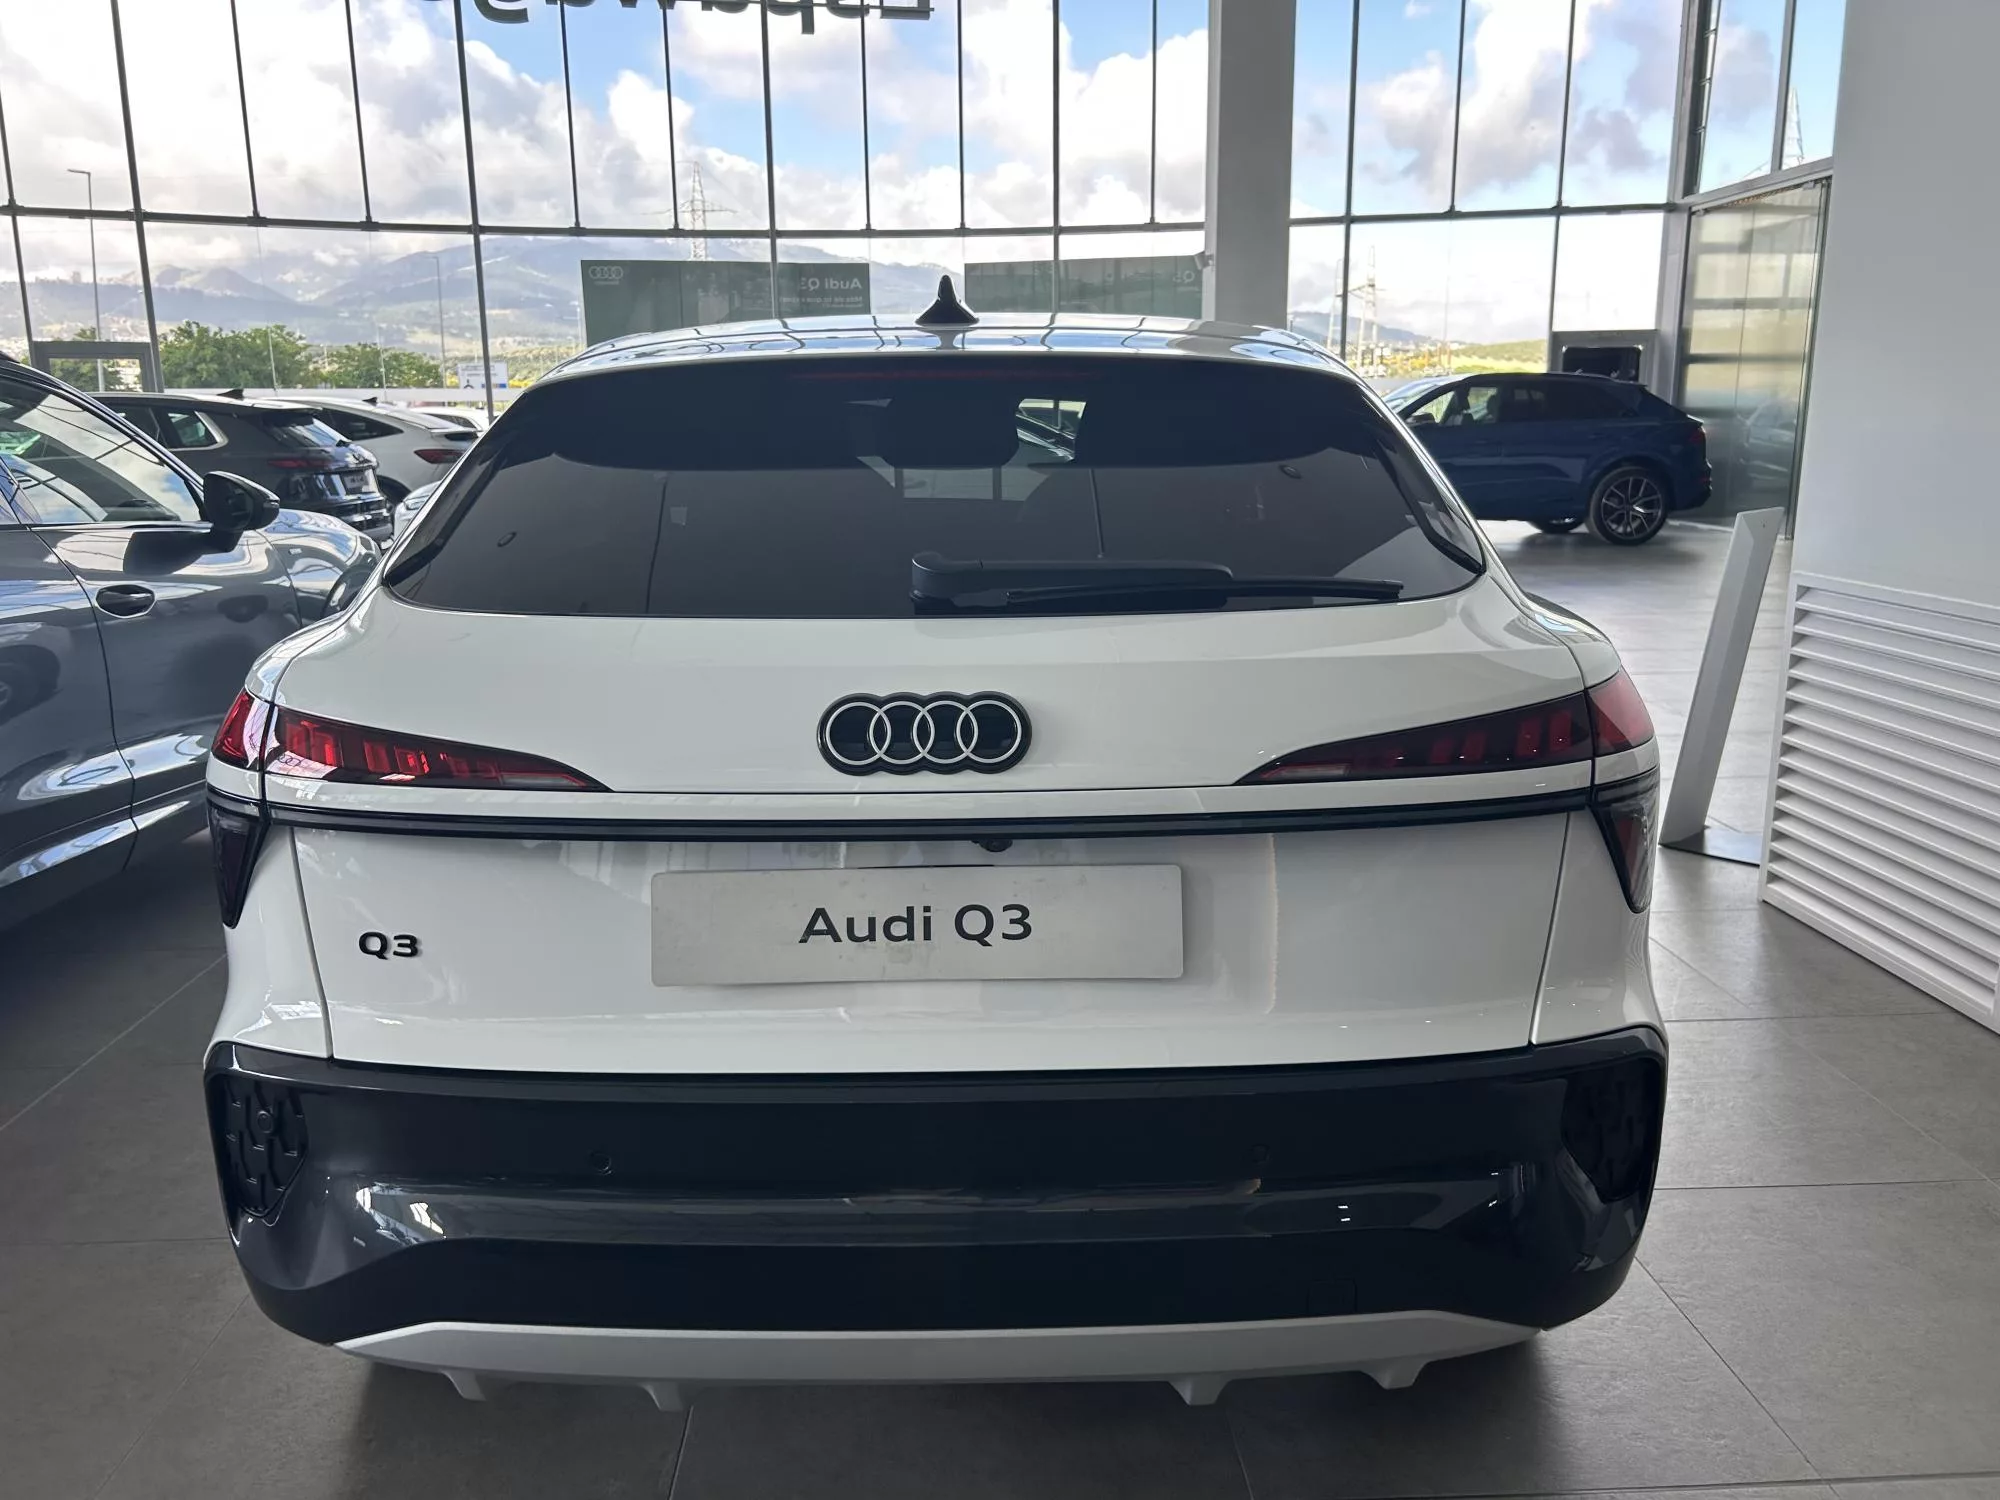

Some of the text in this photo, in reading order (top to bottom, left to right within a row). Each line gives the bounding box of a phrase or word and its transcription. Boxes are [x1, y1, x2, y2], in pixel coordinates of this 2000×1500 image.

[798, 903, 1033, 947] Audi Q3
[358, 931, 420, 960] Q3
